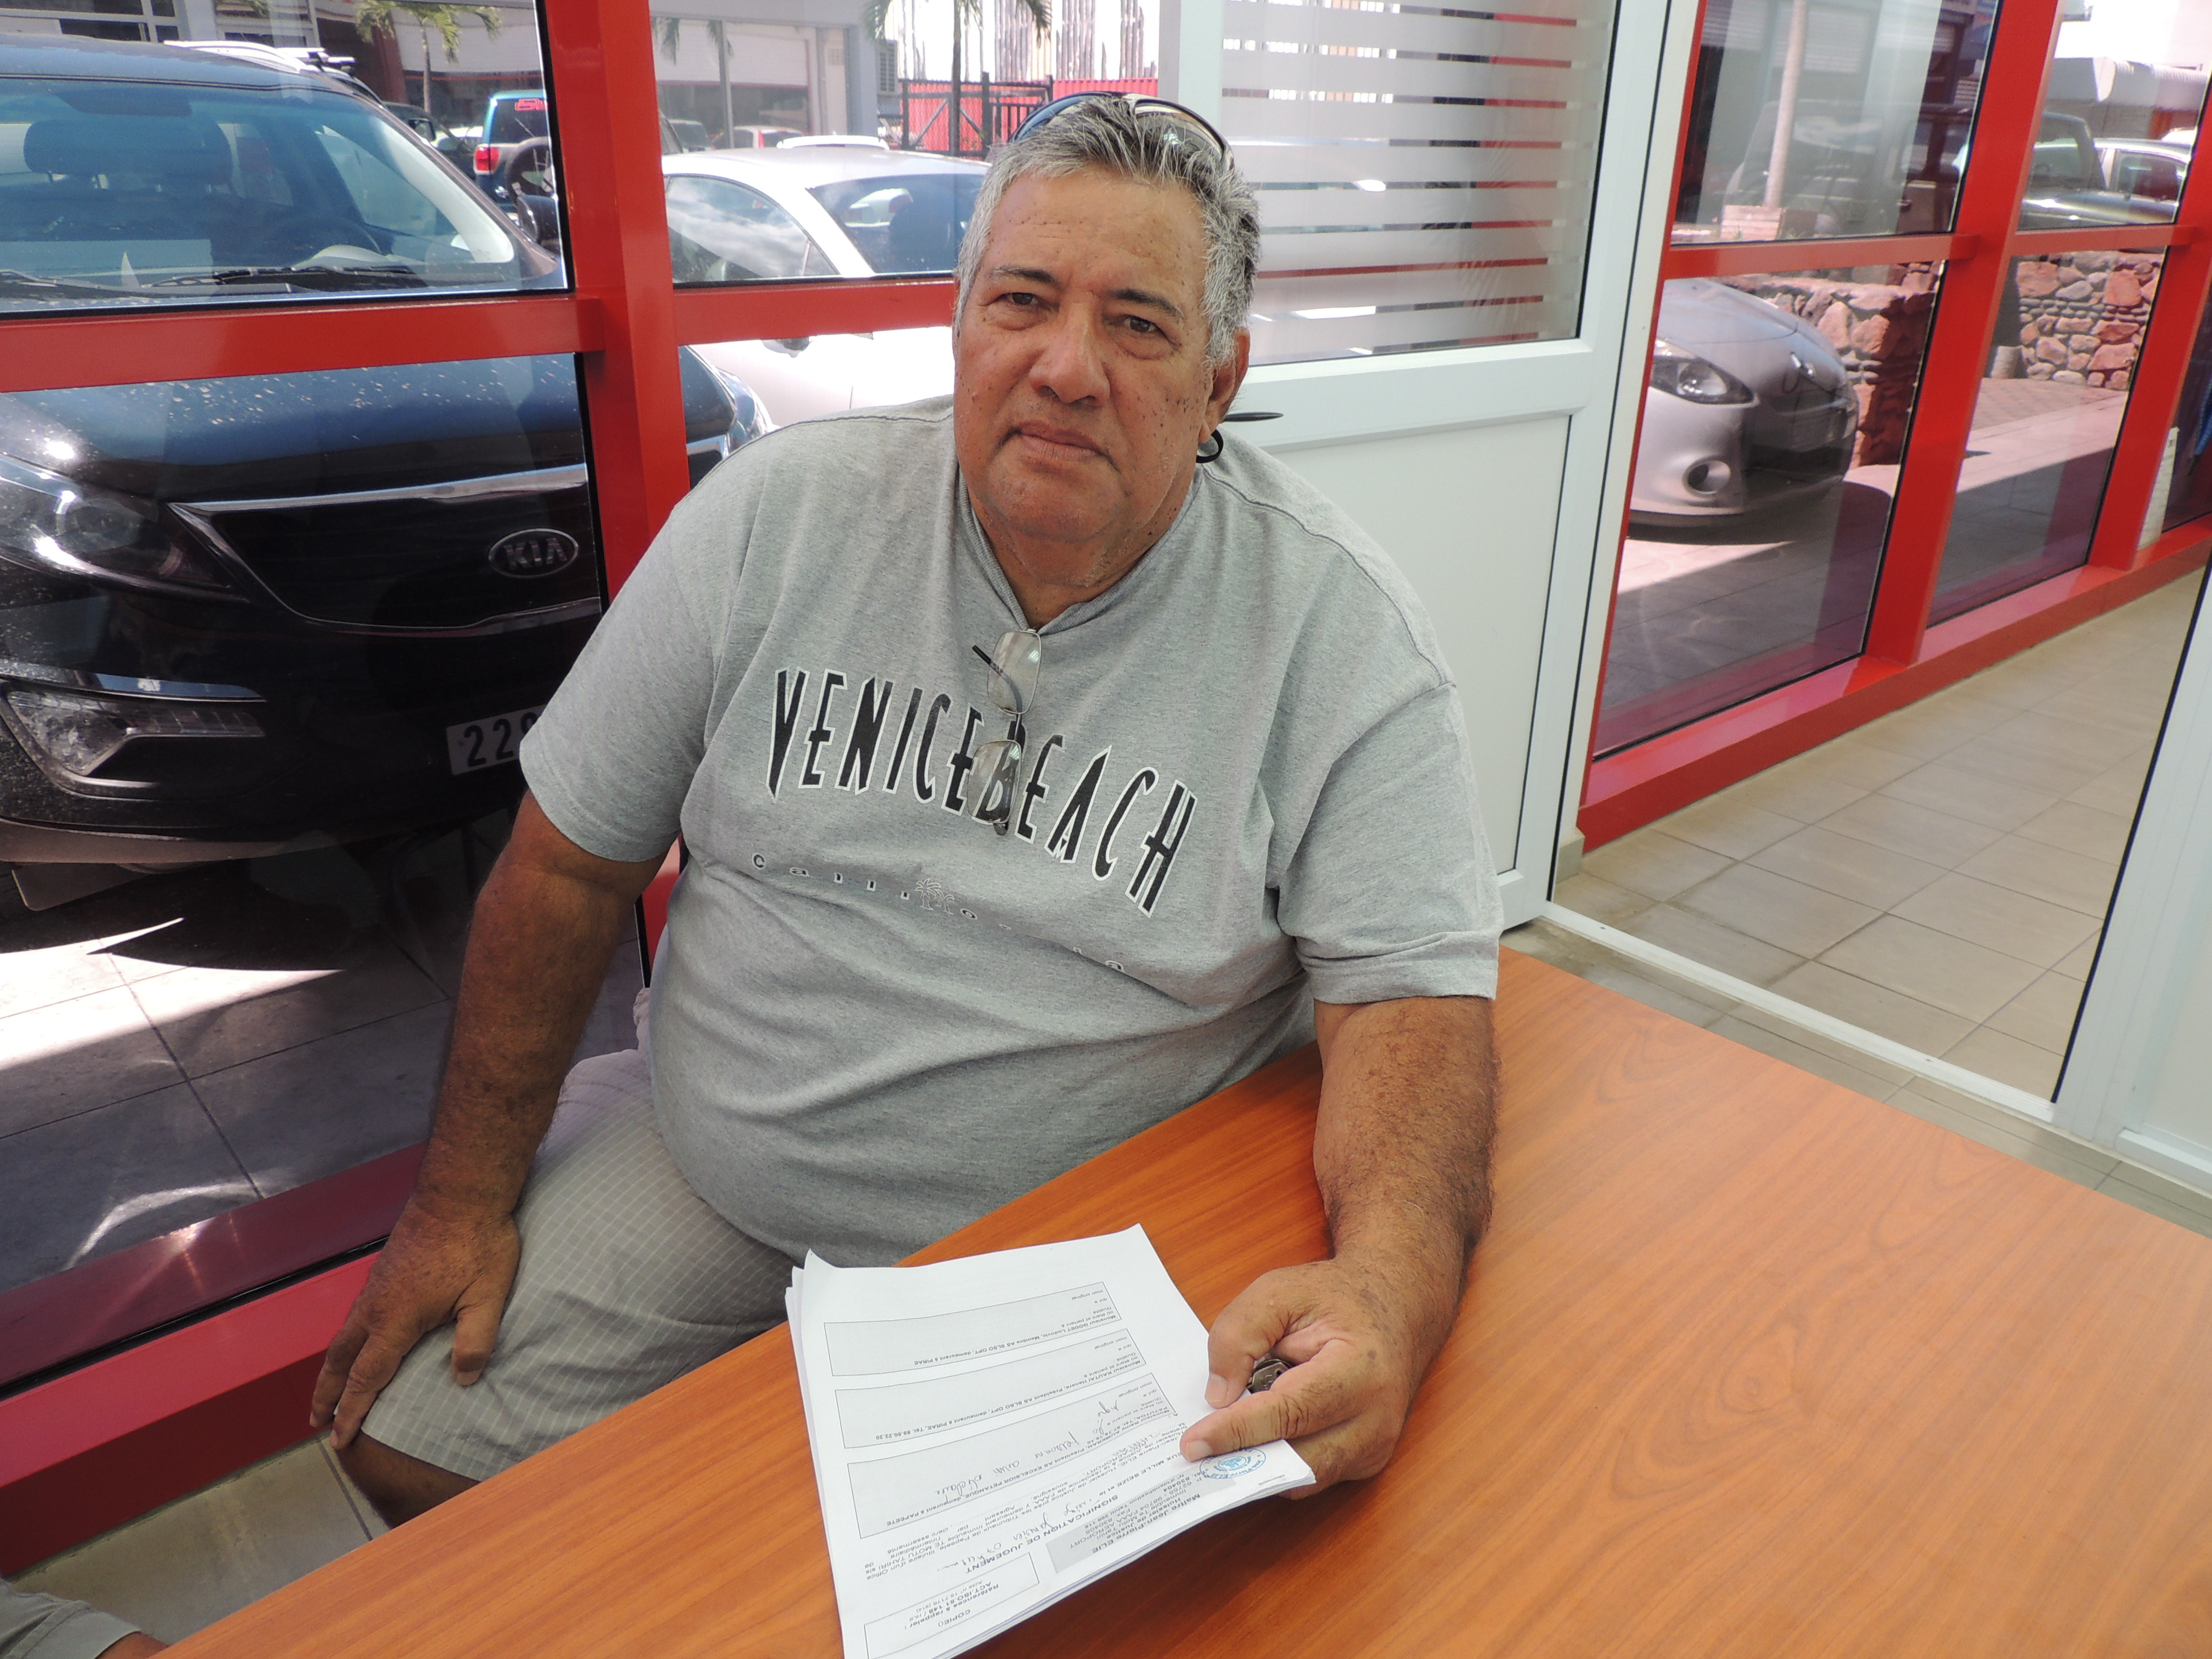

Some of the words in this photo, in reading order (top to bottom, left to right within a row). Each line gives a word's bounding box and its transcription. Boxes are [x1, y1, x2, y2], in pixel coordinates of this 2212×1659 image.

[502, 537, 568, 571] KIA
[766, 666, 983, 816] VENICE
[971, 719, 1197, 917] BEACH
[1071, 1292, 1090, 1300] original
[1089, 1314, 1115, 1325] Monsieur
[1016, 1335, 1039, 1344] Membre
[1094, 1340, 1114, 1350] original
[939, 1351, 971, 1360] demeurant
[1113, 1360, 1140, 1372] Monsieur
[1034, 1387, 1062, 1400] Président
[954, 1410, 987, 1423] demeurant
[1141, 1460, 1164, 1474] MILLE
[1004, 1466, 1042, 1483] EXCELSIOR
[1116, 1472, 1139, 1487] SEIZE
[1148, 1497, 1181, 1517] Huissier
[1171, 1493, 1200, 1511] Maître
[1042, 1494, 1118, 1537] SIGNIFICATION
[1106, 1522, 1135, 1539] Justice
[1116, 1509, 1169, 1541] Jean-Pierre
[1026, 1535, 1041, 1545] DE
[1091, 1539, 1114, 1553] ELIE
[907, 1545, 932, 1558] MOTU
[964, 1542, 1024, 1574] JUGEMENT
[866, 1569, 889, 1581] Office
[952, 1583, 999, 1608] Références
